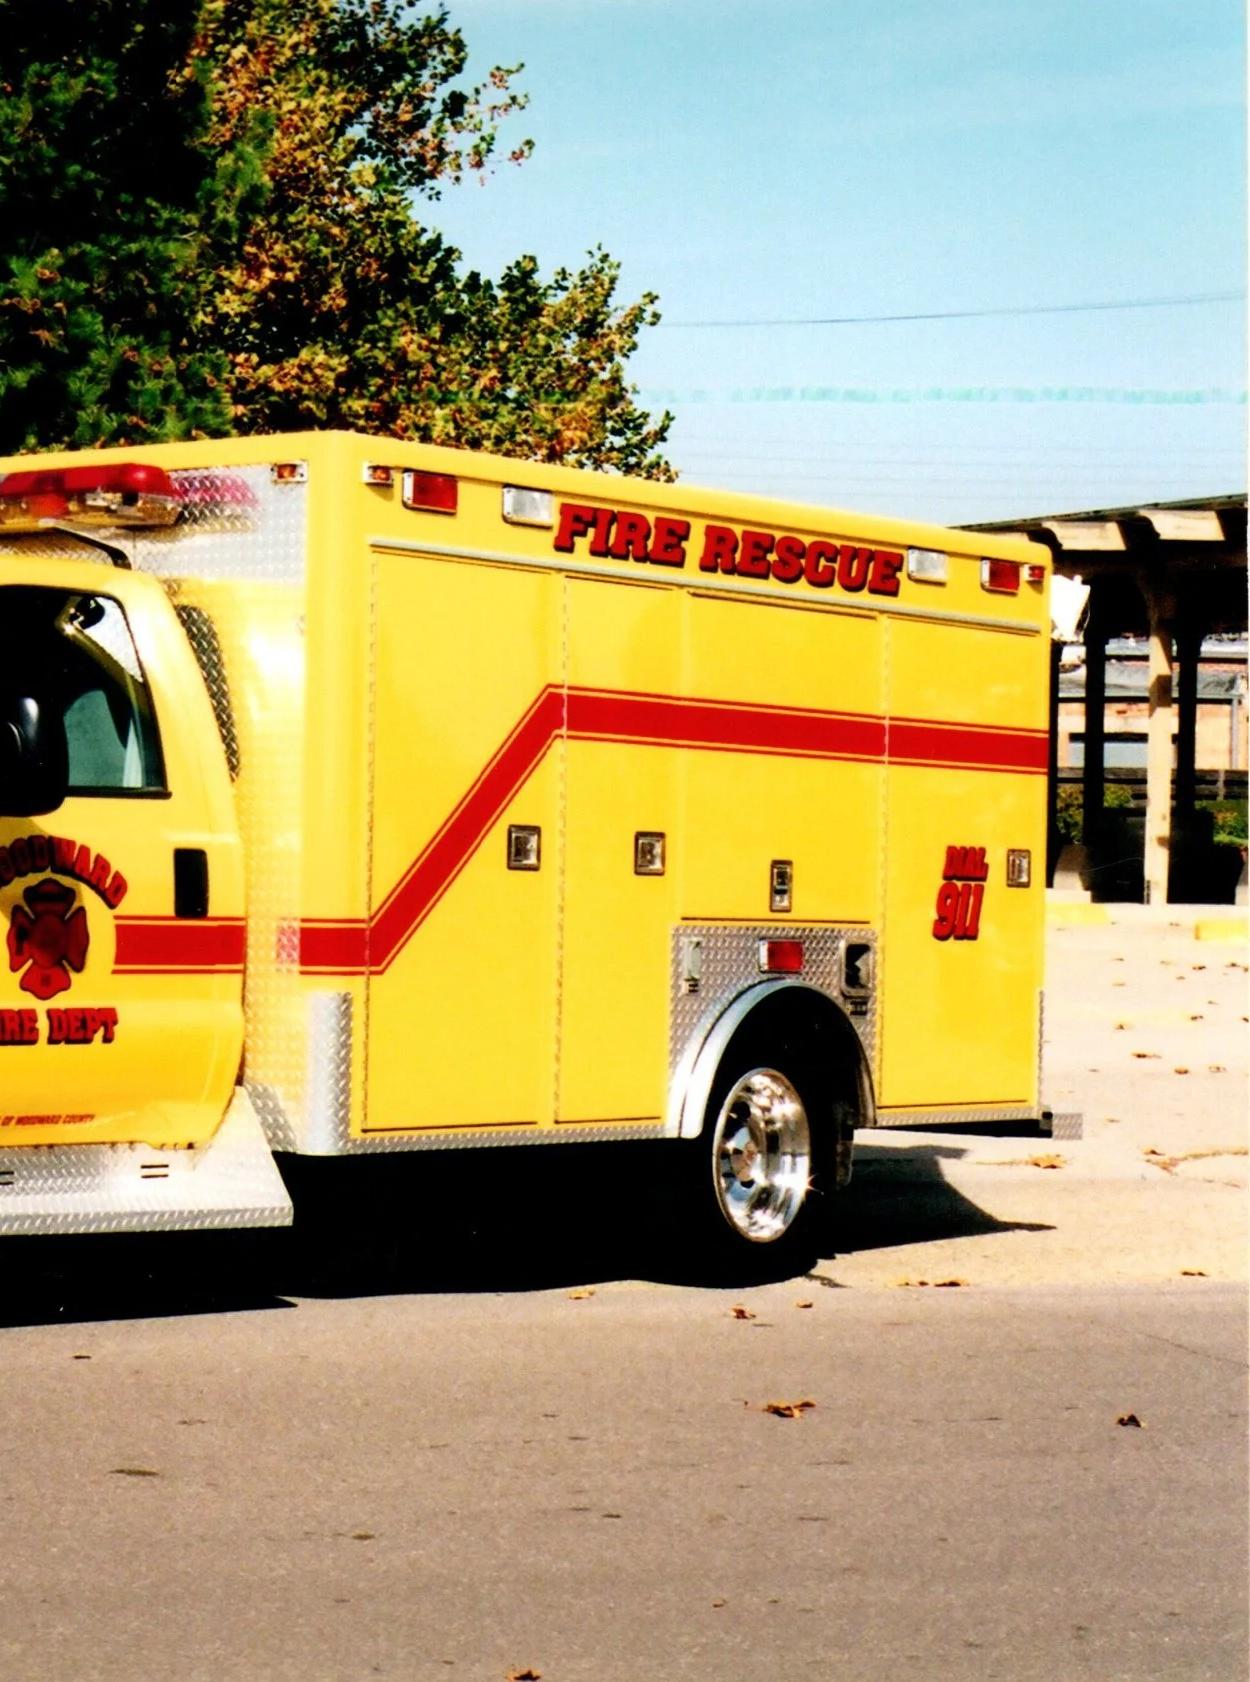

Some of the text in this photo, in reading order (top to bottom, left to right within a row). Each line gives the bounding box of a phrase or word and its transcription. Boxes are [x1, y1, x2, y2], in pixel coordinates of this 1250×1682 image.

[554, 502, 905, 598] FIRE RESCUE
[942, 845, 989, 882] DIAL
[932, 881, 985, 941] 911
[46, 1007, 119, 1045] DEPT
[1, 1115, 15, 1126] OF
[15, 1114, 62, 1125] WOODWARD
[62, 1113, 96, 1124] COUNTY
